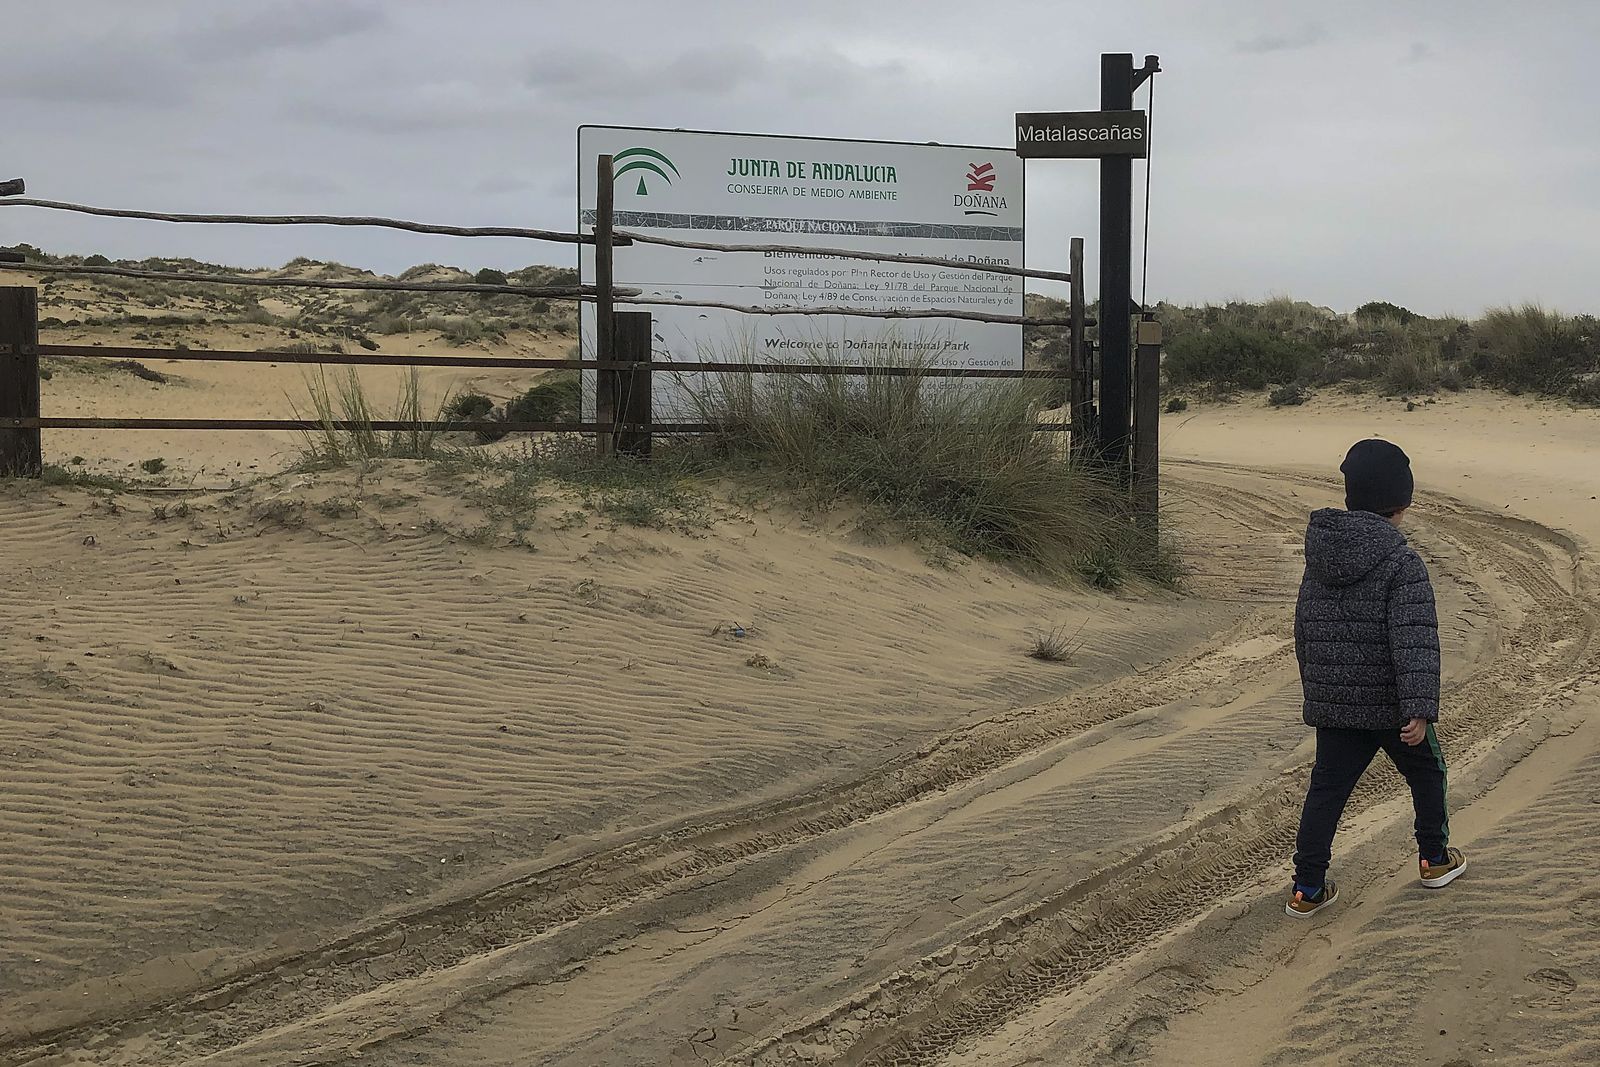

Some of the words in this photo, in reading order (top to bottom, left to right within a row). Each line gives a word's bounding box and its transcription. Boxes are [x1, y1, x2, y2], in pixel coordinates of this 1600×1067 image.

[1018, 124, 1142, 142] Matalascañas
[727, 158, 780, 178] JUNTA
[786, 161, 806, 179] DE
[812, 162, 897, 183] ANDALUCIA
[727, 184, 788, 196] CONSEJERIA
[793, 187, 806, 197] DE
[811, 188, 844, 199] MEDIO
[849, 189, 897, 201] AMBIENTE
[954, 193, 1007, 209] DOÑANA
[765, 219, 805, 231] PARQUE
[808, 220, 859, 233] NACIONAL
[967, 254, 1010, 266] Doñana
[764, 266, 786, 275] Usos
[788, 267, 829, 278] regulados
[870, 269, 899, 278] Rector
[901, 270, 911, 279] de
[913, 270, 929, 279] Uso
[931, 273, 937, 281] y
[938, 271, 970, 280] Gestión
[972, 273, 983, 281] del
[985, 273, 1013, 283] Parque
[764, 279, 802, 288] Nacional
[808, 280, 818, 288] de
[864, 281, 879, 291] Ley
[913, 282, 925, 291] del
[930, 283, 959, 293] Parque
[963, 284, 998, 293] Nacional
[802, 292, 817, 302] Ley
[840, 293, 850, 301] de
[911, 295, 921, 303] de
[922, 295, 956, 305] Espacios
[958, 295, 996, 305] Naturales
[997, 297, 1003, 307] y
[1004, 296, 1013, 305] de
[765, 338, 823, 349] Welcome
[844, 339, 888, 350] Doñana
[892, 340, 940, 351] National
[943, 340, 970, 351] Park
[960, 360, 966, 369] y
